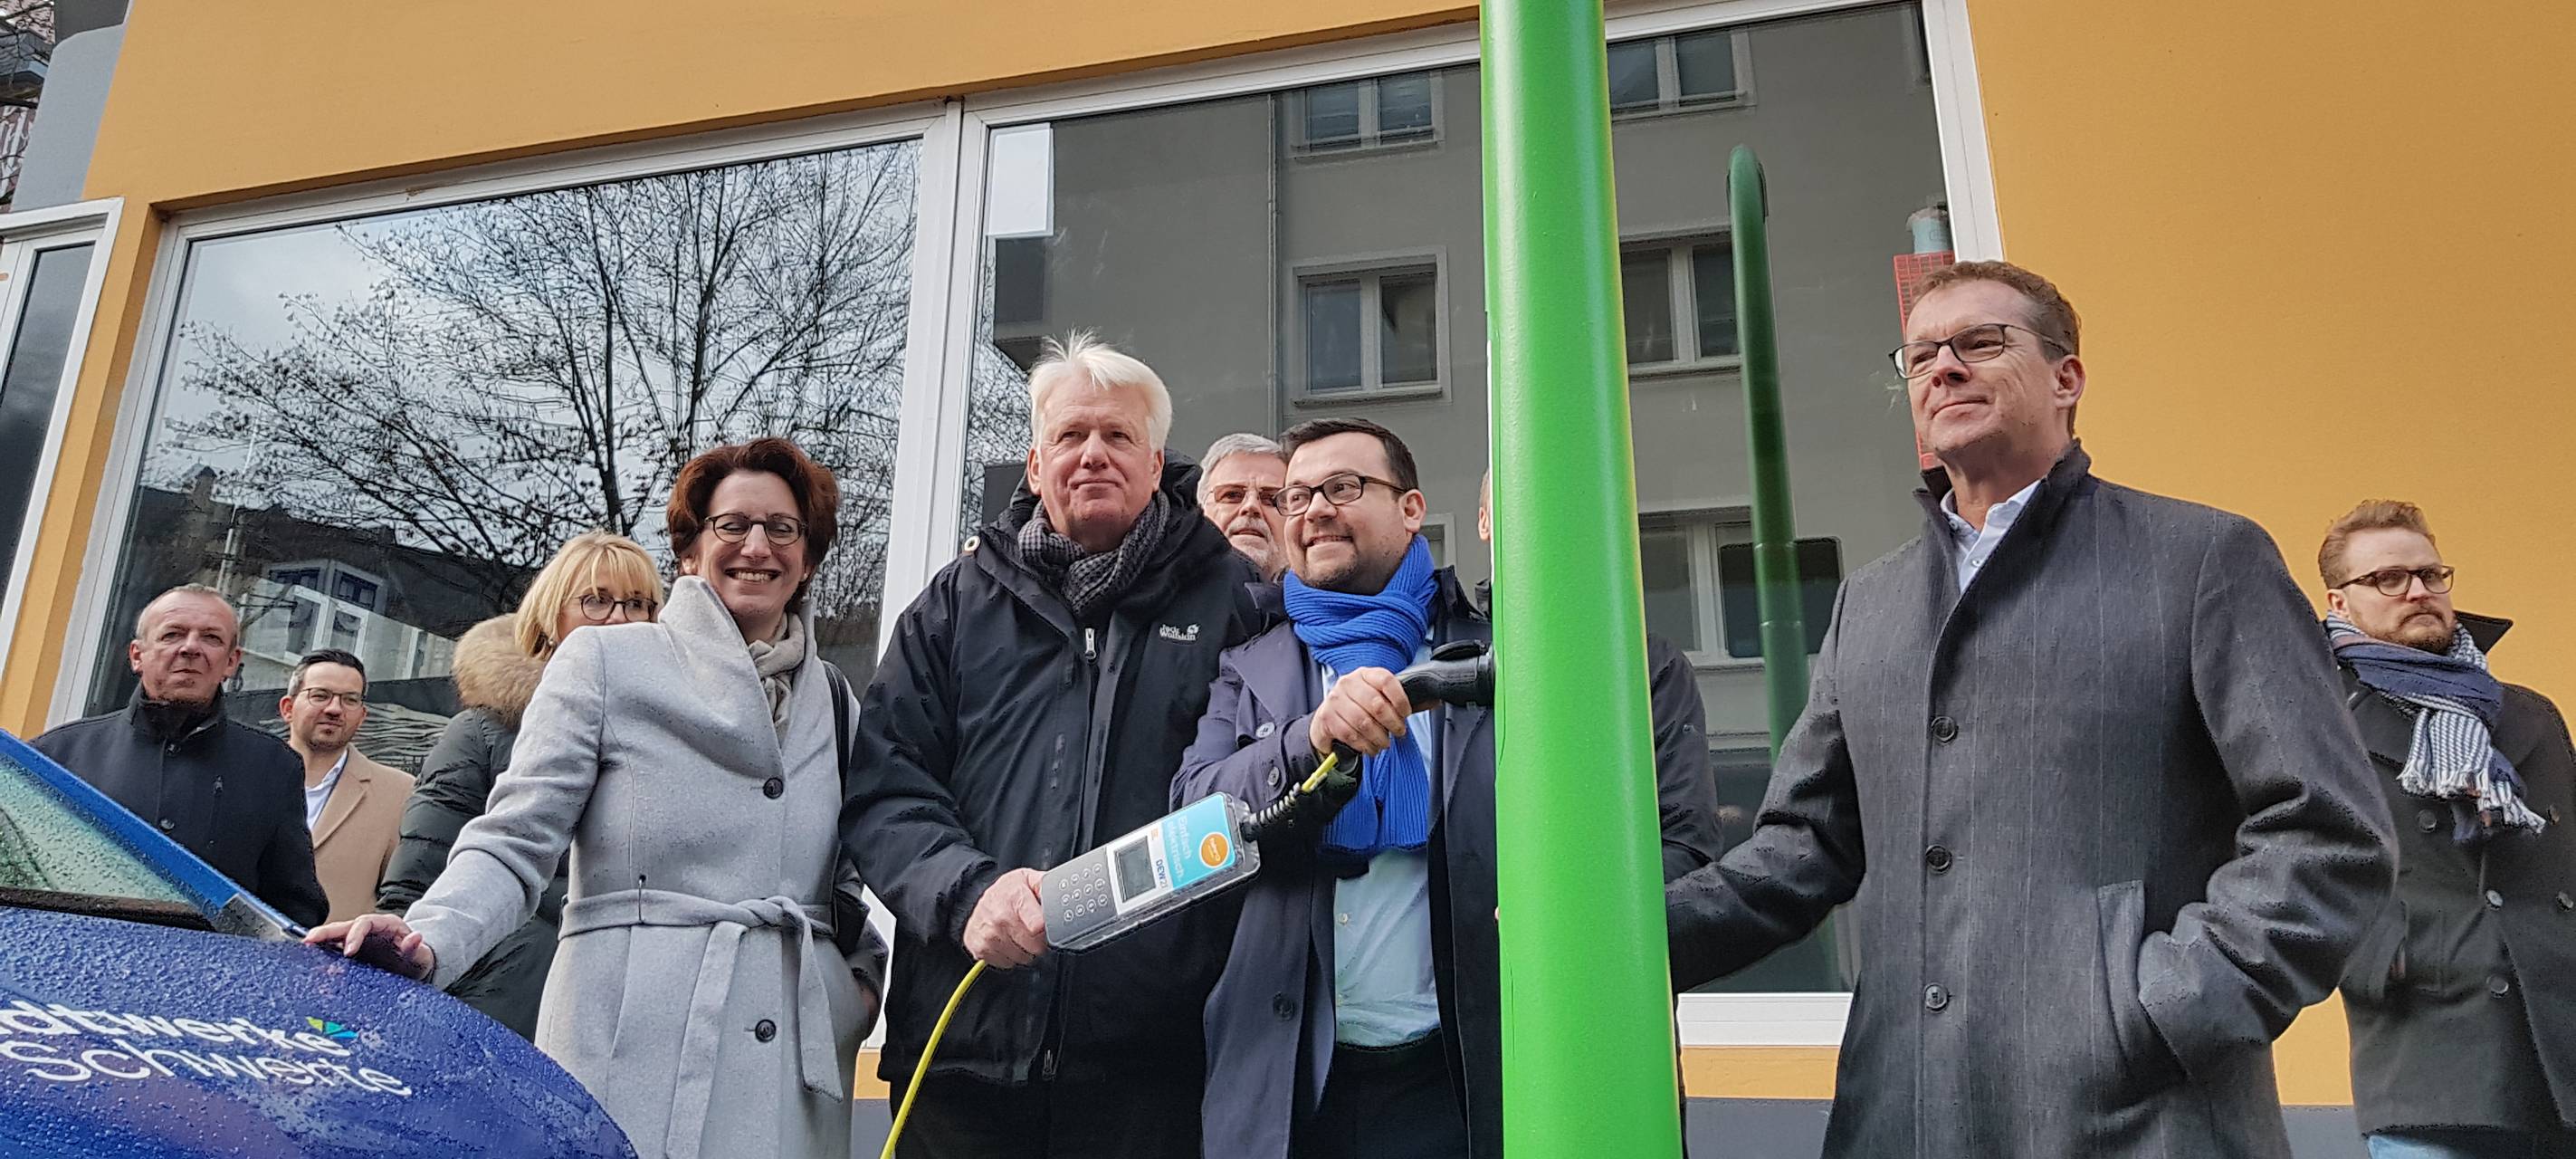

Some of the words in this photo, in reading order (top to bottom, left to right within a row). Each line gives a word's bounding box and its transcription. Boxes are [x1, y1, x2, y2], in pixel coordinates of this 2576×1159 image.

[1159, 631, 1196, 641] Wolfskin
[1156, 858, 1169, 888] DEW21
[0, 1000, 350, 1057] dtwerke
[0, 1038, 413, 1097] Schwerte
